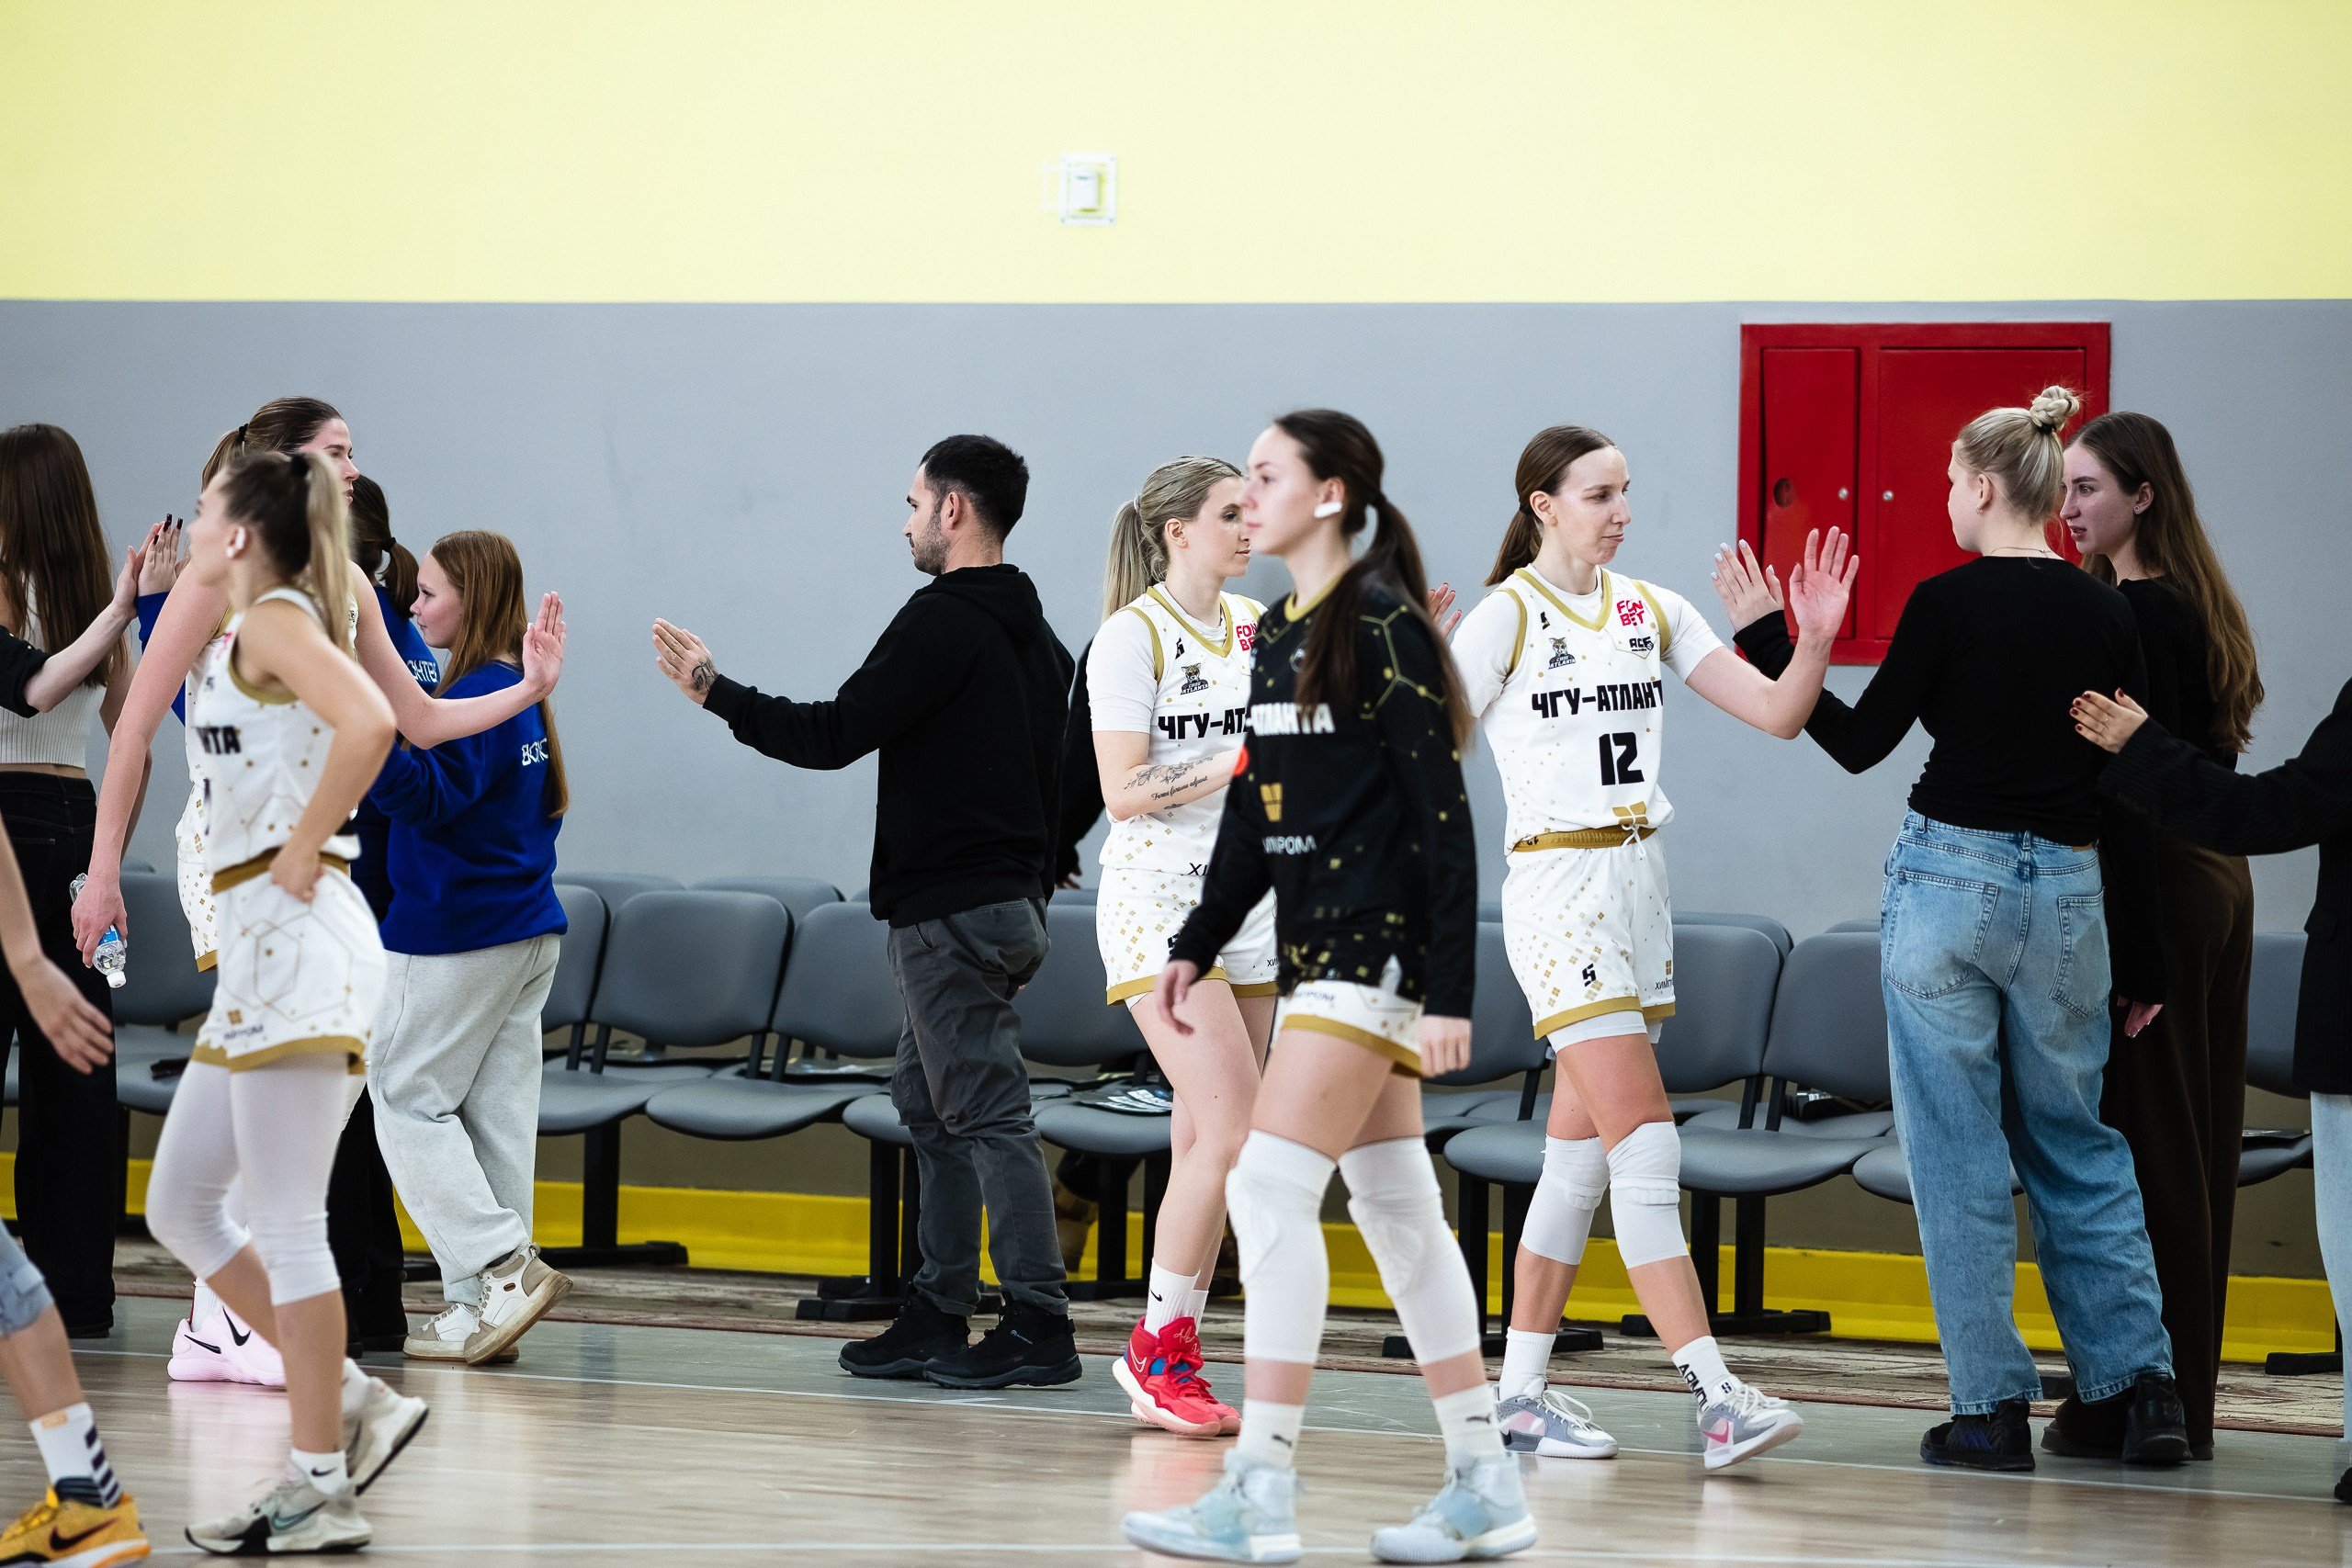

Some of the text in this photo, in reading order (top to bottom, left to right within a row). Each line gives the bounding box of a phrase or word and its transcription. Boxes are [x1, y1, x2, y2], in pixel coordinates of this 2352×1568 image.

[1617, 600, 1644, 615] FON
[1620, 610, 1645, 626] BET
[1158, 706, 1247, 739] ЧГУ-АТ
[1599, 732, 1645, 785] 12
